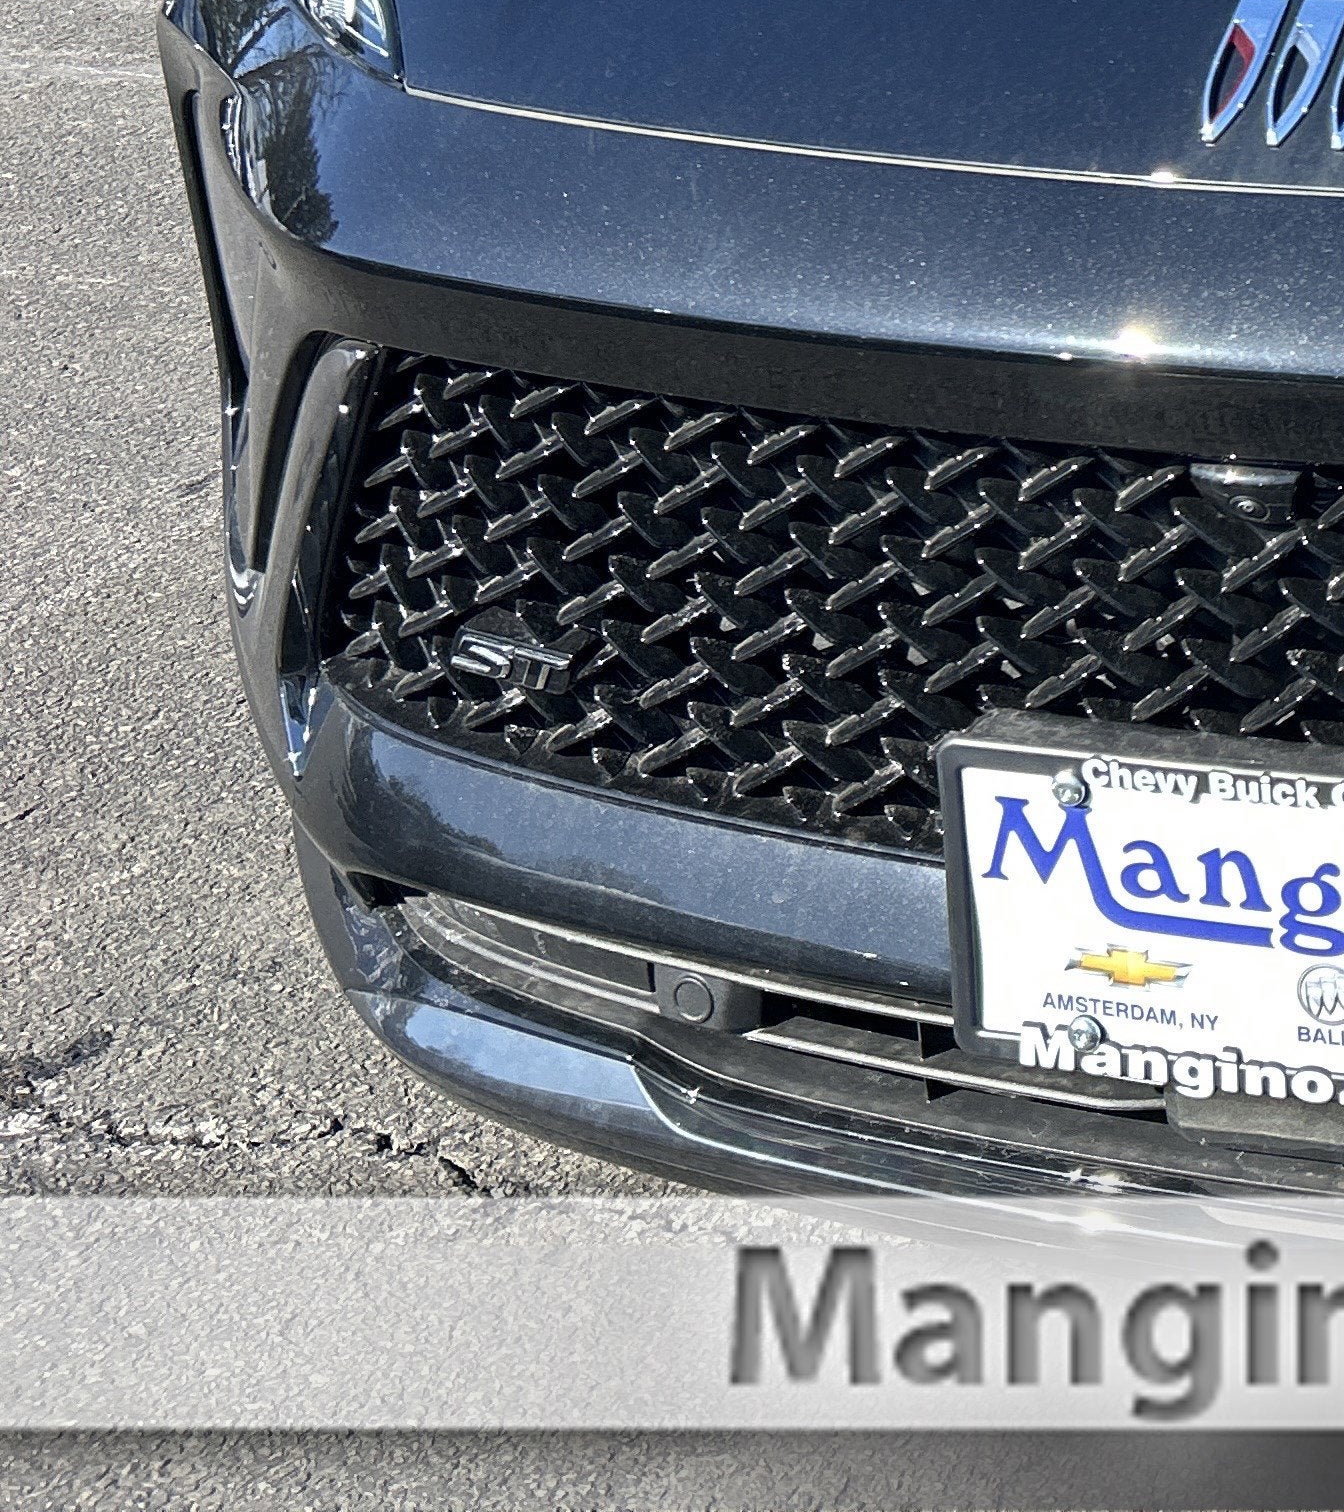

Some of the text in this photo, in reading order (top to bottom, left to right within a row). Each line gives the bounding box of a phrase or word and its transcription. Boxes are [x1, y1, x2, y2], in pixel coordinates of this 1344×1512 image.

[1081, 757, 1199, 803] Chevy
[1207, 769, 1321, 808] Buick
[1042, 992, 1219, 1031] AMSTERDAM, NY
